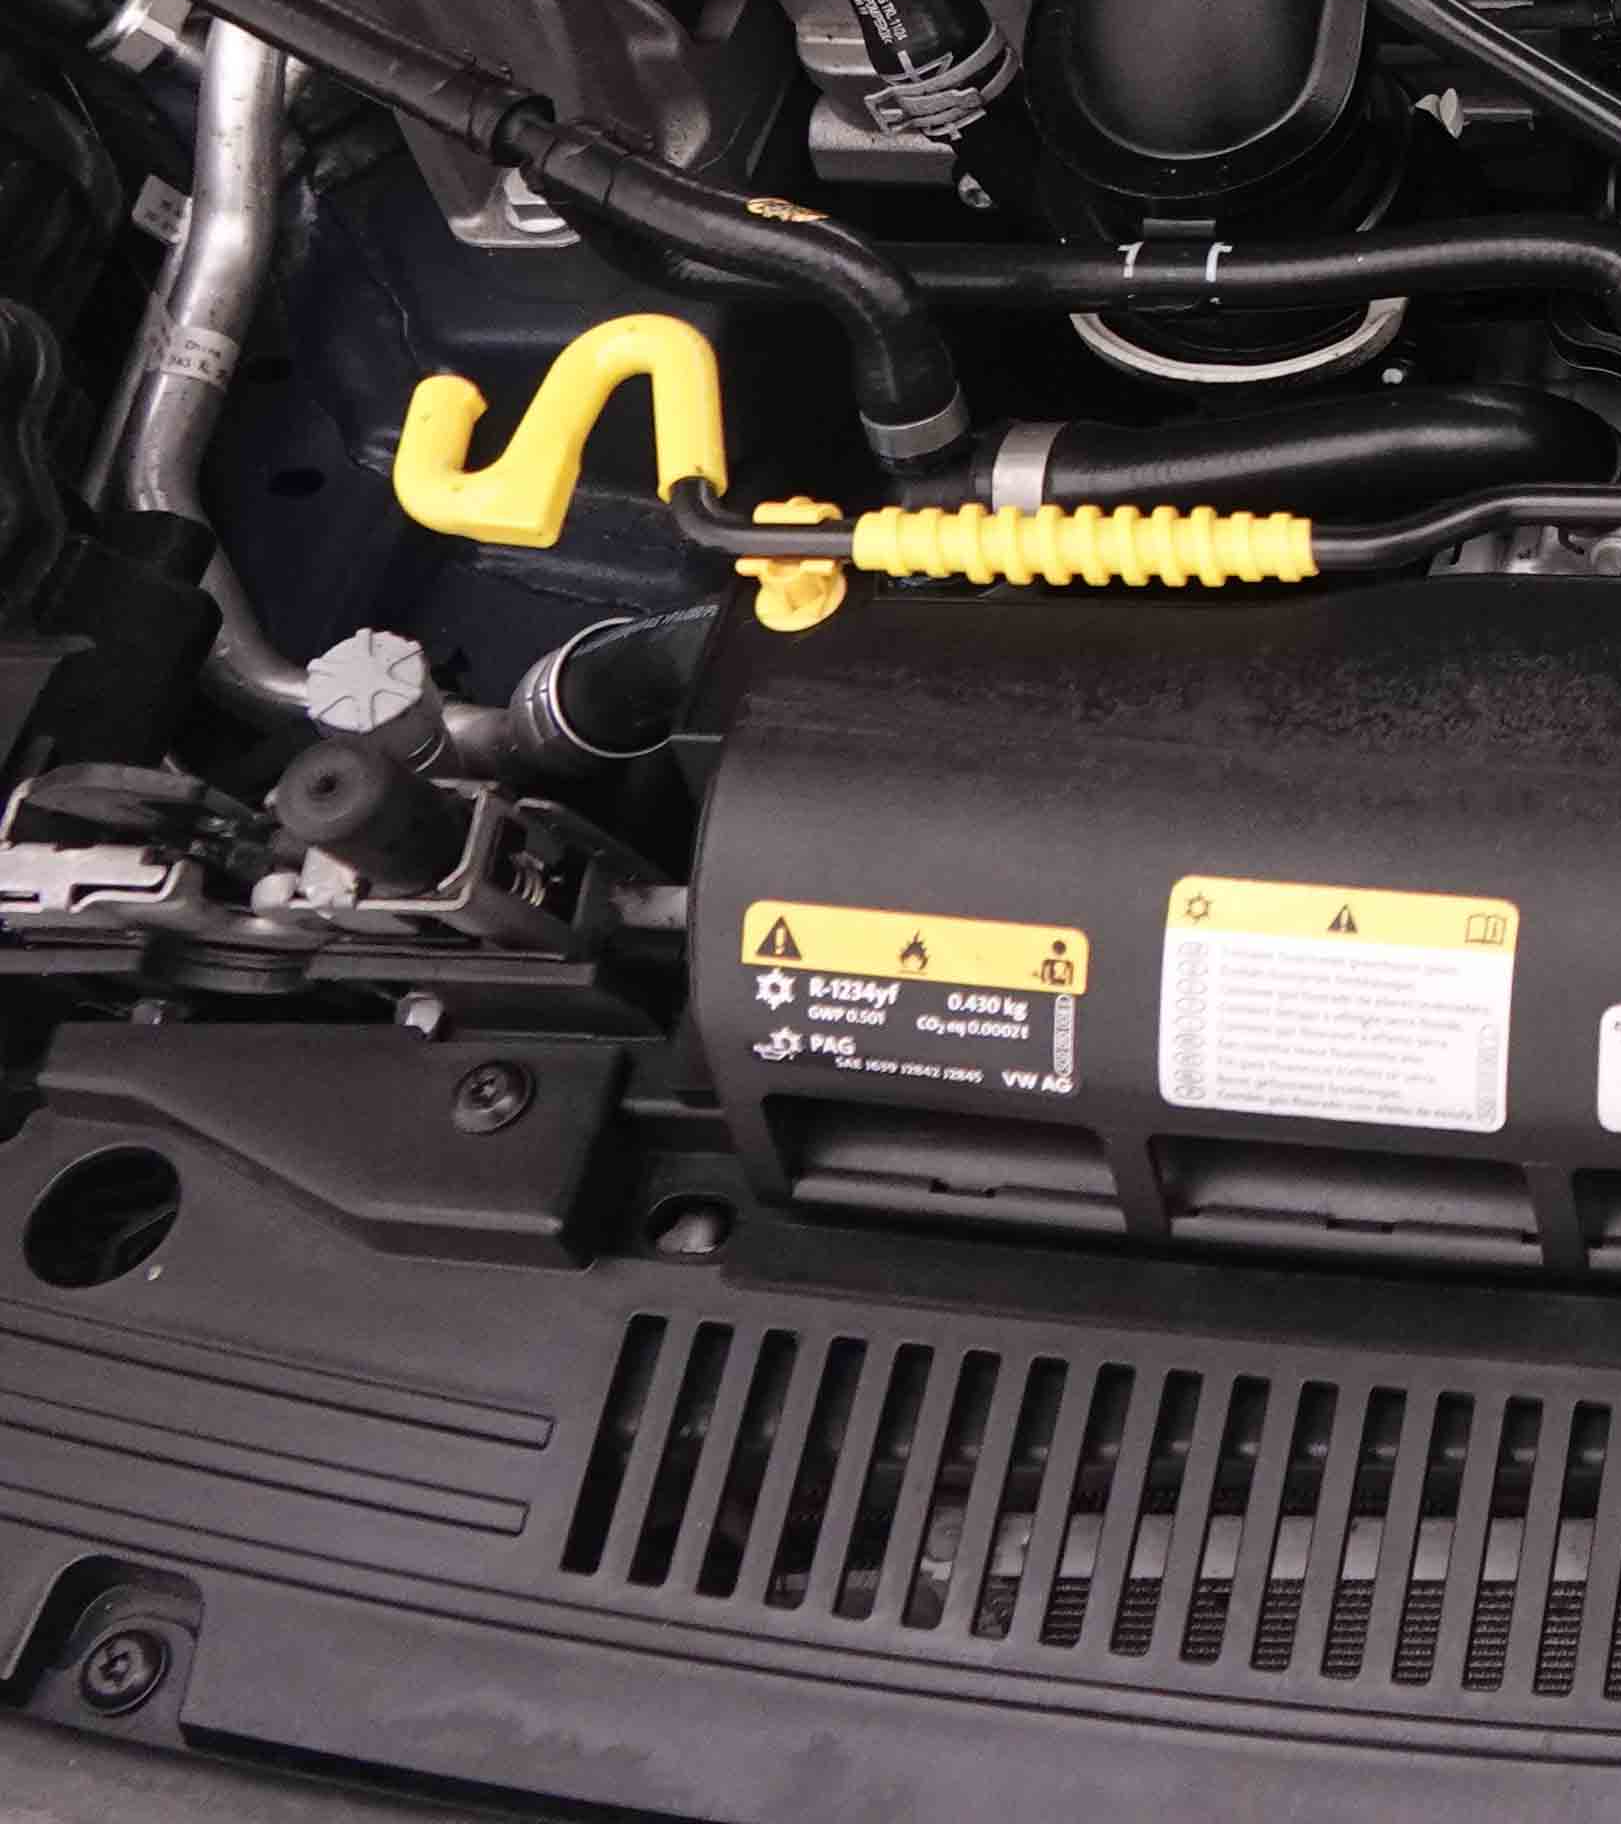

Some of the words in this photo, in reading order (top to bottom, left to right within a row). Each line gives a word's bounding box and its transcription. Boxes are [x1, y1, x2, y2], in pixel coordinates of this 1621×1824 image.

[808, 976, 902, 1009] R-1234yf
[946, 992, 1000, 1015] 0.430
[1002, 997, 1029, 1022] kg
[807, 1005, 843, 1024] GWP
[808, 1033, 857, 1057] PAG
[1001, 1070, 1038, 1091] VW
[1040, 1075, 1075, 1095] AG
